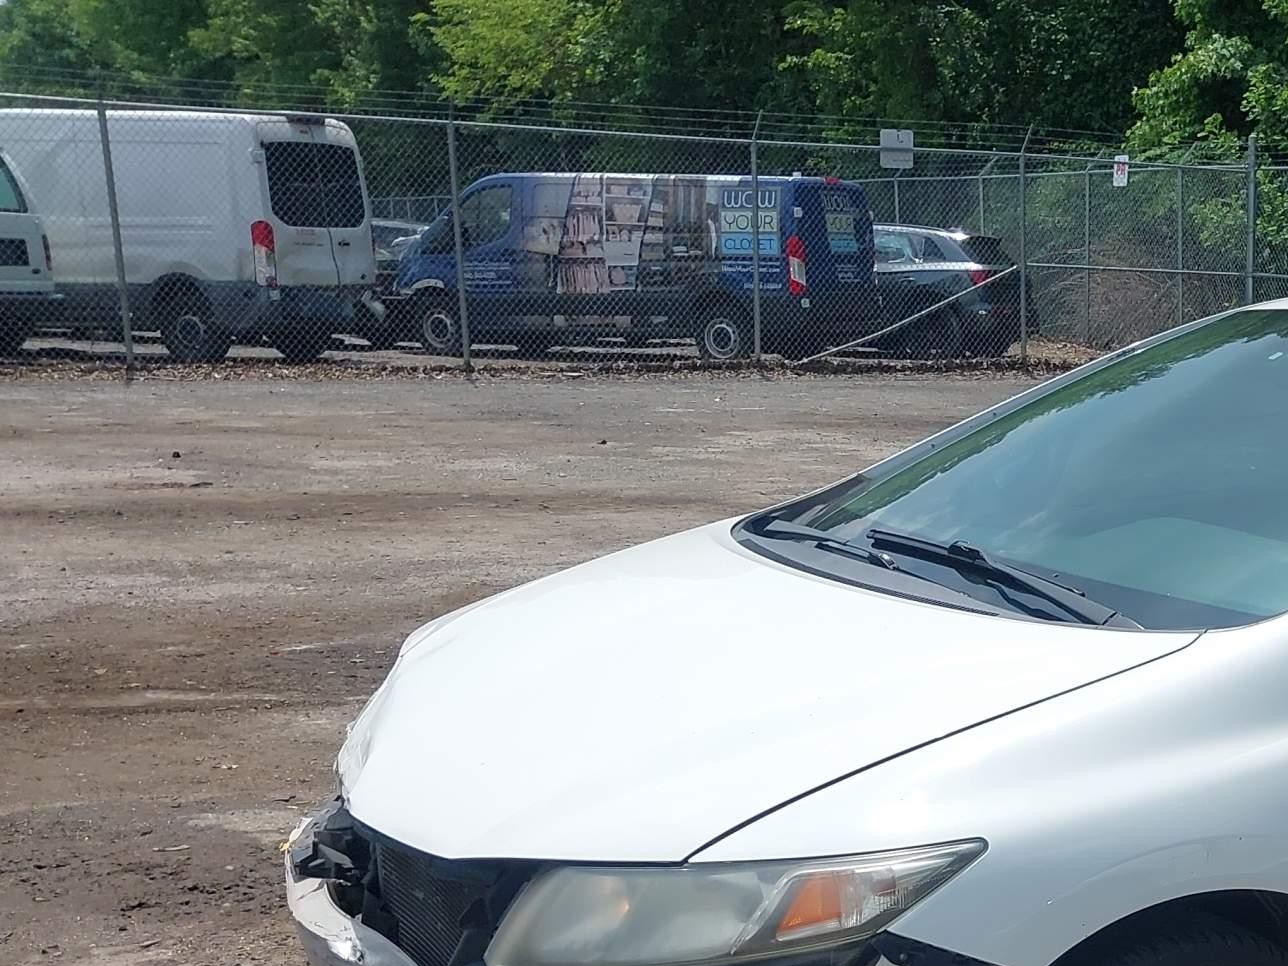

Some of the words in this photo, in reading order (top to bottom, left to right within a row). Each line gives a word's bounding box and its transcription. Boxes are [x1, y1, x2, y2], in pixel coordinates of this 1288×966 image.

[723, 190, 776, 208] WOW
[723, 214, 775, 231] YOUR
[724, 238, 775, 250] CLOET
